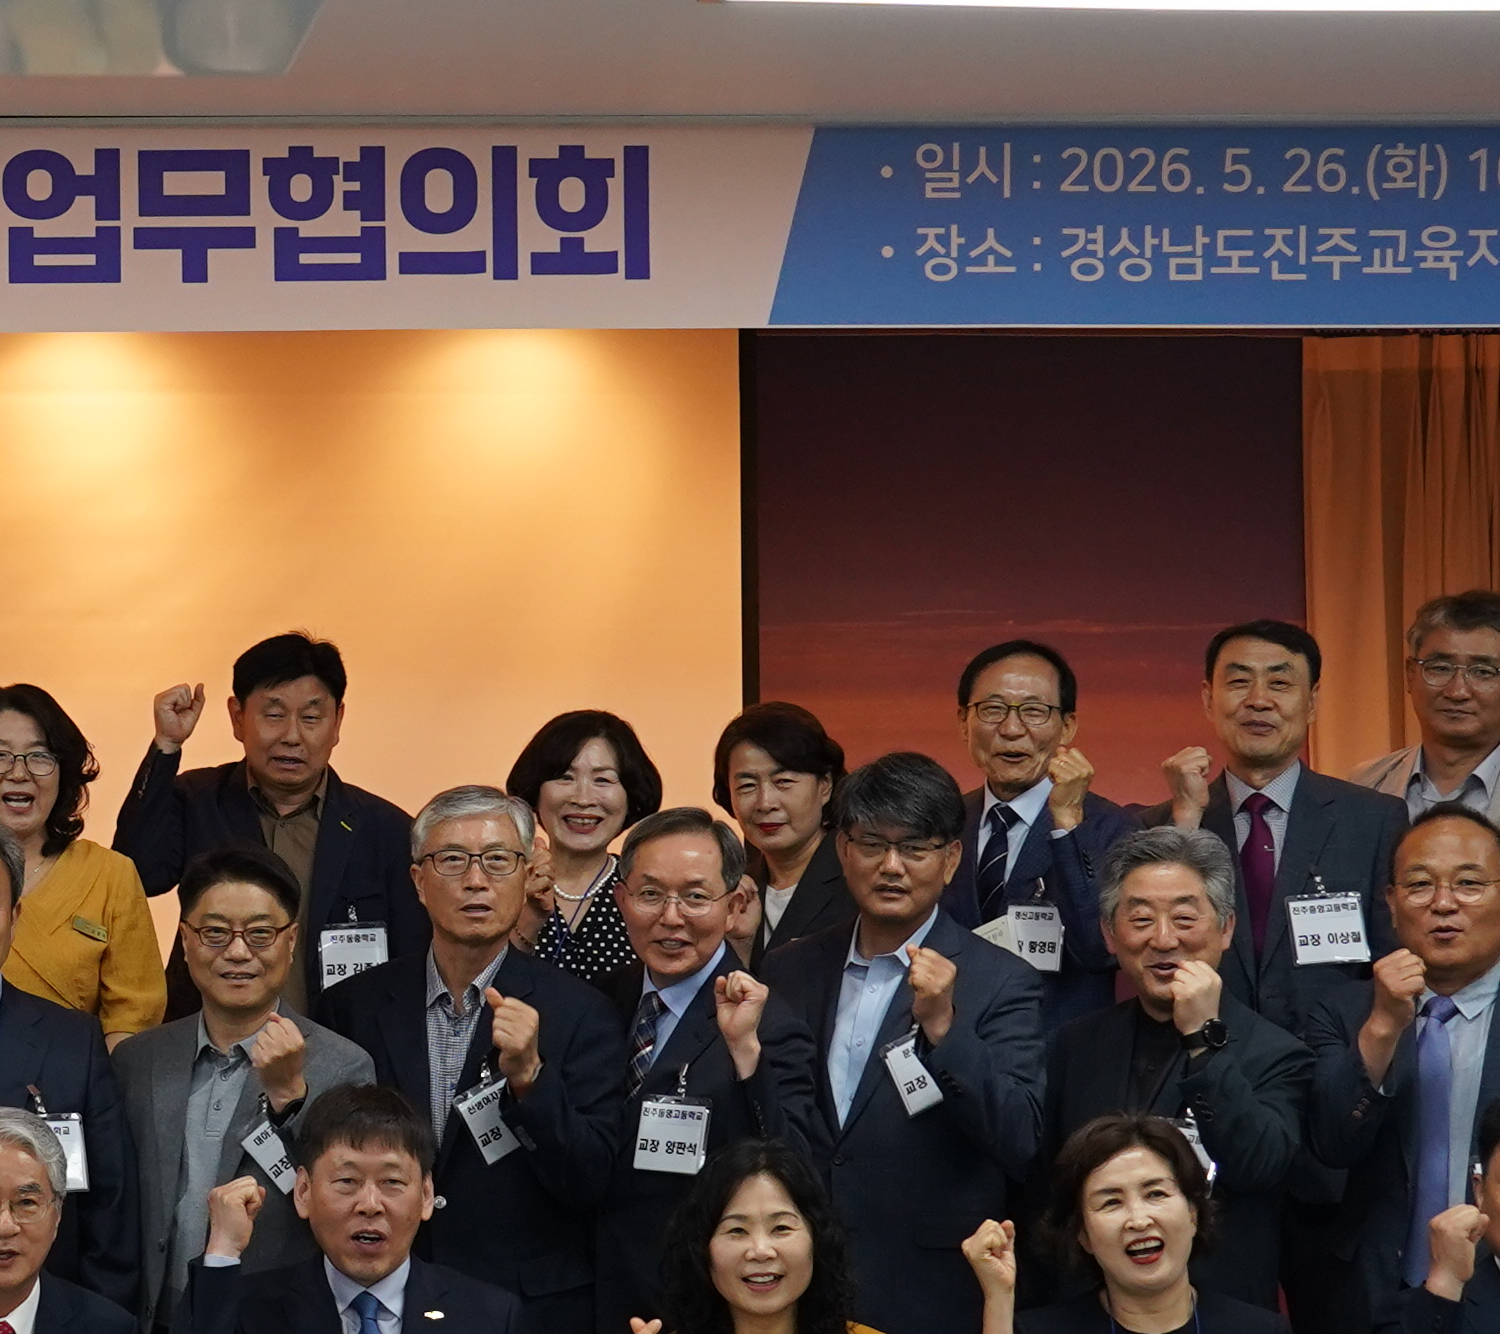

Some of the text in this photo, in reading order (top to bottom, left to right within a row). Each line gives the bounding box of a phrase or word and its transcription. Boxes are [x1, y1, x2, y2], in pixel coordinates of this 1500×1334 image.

[916, 143, 1010, 198] 일시
[1060, 147, 1204, 194] 2026.
[1223, 148, 1265, 194] 5.
[1282, 143, 1447, 200] 26.(화)
[916, 225, 1016, 281] 장소
[1292, 903, 1358, 915] 진주중앙고등학교
[1299, 932, 1361, 946] 교장 이상철
[326, 964, 348, 976] 교장
[904, 1075, 929, 1095] 교장
[642, 1107, 703, 1121] 진주동명고등학교
[478, 1126, 502, 1149] 교장
[638, 1138, 697, 1155] 교장 양판석
[268, 1154, 293, 1180] 교장
